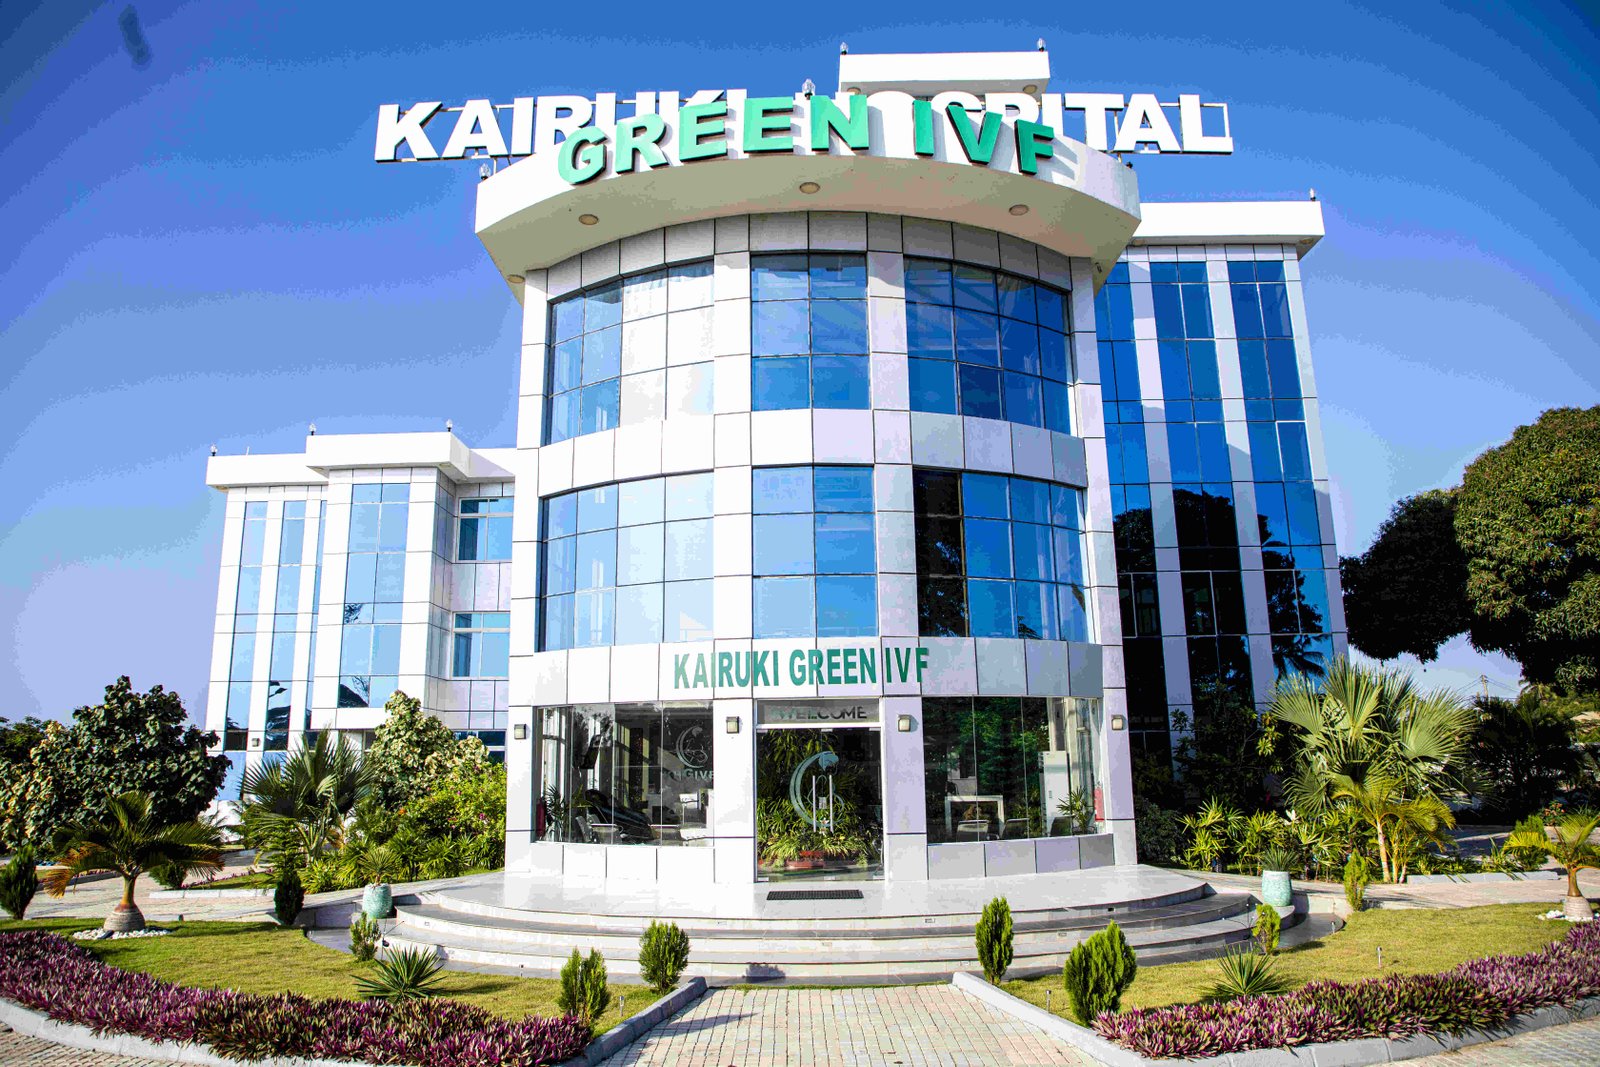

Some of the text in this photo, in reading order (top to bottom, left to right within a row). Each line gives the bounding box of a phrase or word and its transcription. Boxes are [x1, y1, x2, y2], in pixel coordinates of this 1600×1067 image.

[374, 89, 1234, 163] KAIR PITAL
[557, 95, 1055, 186] GREEN IVF
[674, 647, 929, 689] KAIRUKI GREEN IVF
[771, 705, 868, 720] WELCOME
